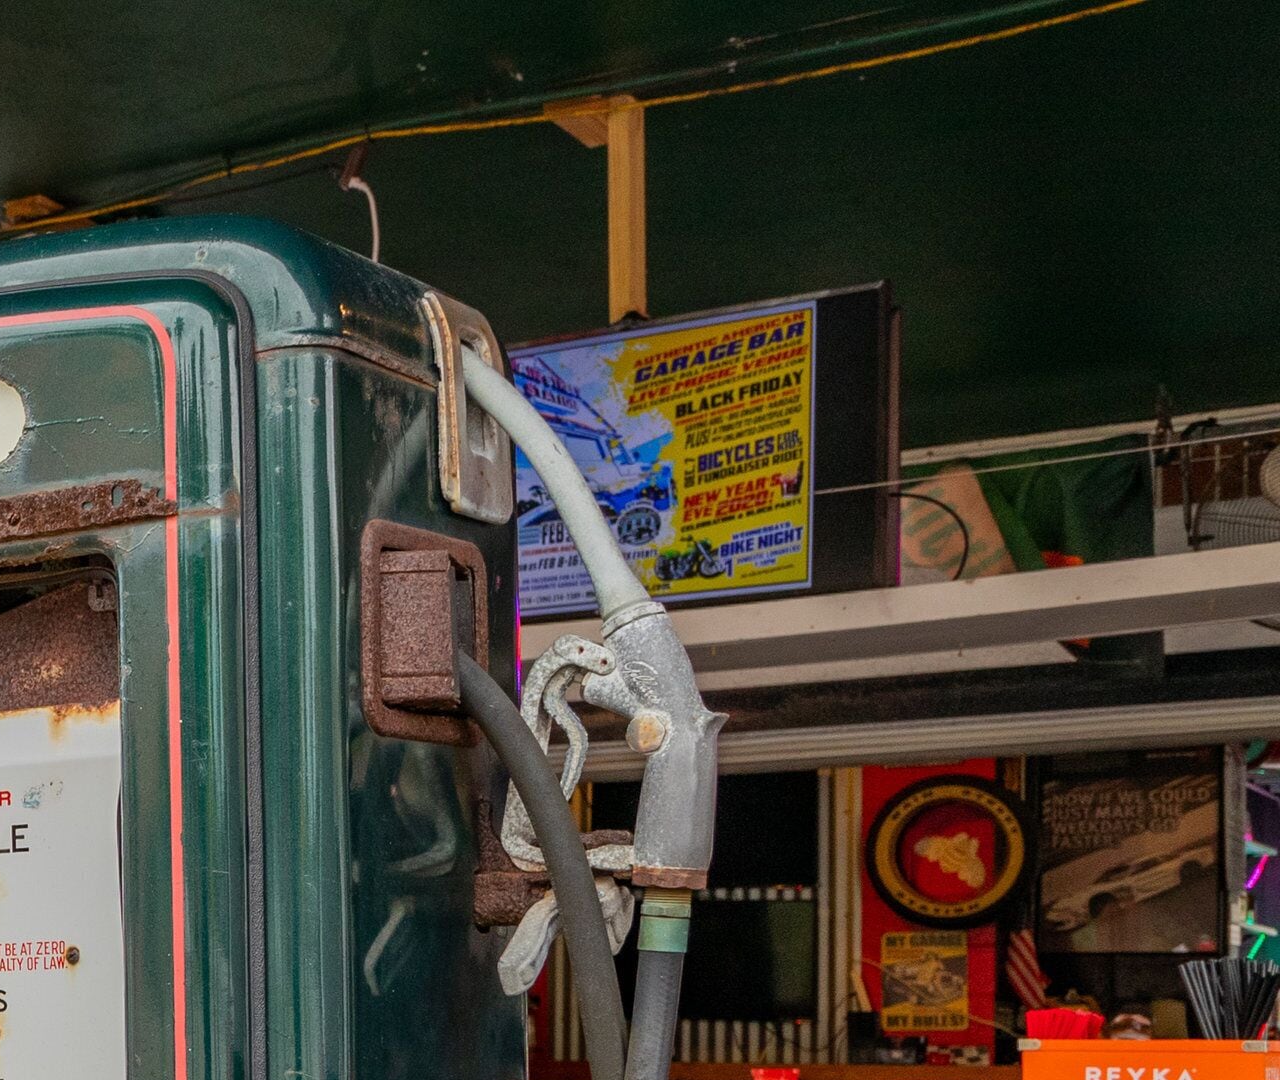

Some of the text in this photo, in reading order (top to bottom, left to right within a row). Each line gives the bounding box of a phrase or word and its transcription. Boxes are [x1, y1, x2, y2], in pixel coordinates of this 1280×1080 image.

[634, 321, 806, 383] GARAGE BAR
[628, 344, 809, 405] LIVE MUSIC VENUE
[675, 389, 735, 419] BLACK
[738, 368, 803, 399] FRIDAY
[698, 436, 775, 472] BICYCLES
[698, 457, 769, 486] FUNDRAISER
[683, 488, 721, 509] NEW
[683, 507, 712, 523] EVE
[541, 523, 564, 545] FEB
[720, 527, 803, 558] BIKE NIGHT
[538, 558, 557, 569] FEB
[1148, 786, 1211, 801] COULD
[5, 942, 17, 957] BE
[20, 942, 32, 956] AT
[36, 940, 66, 955] ZERO
[27, 956, 39, 970] OF
